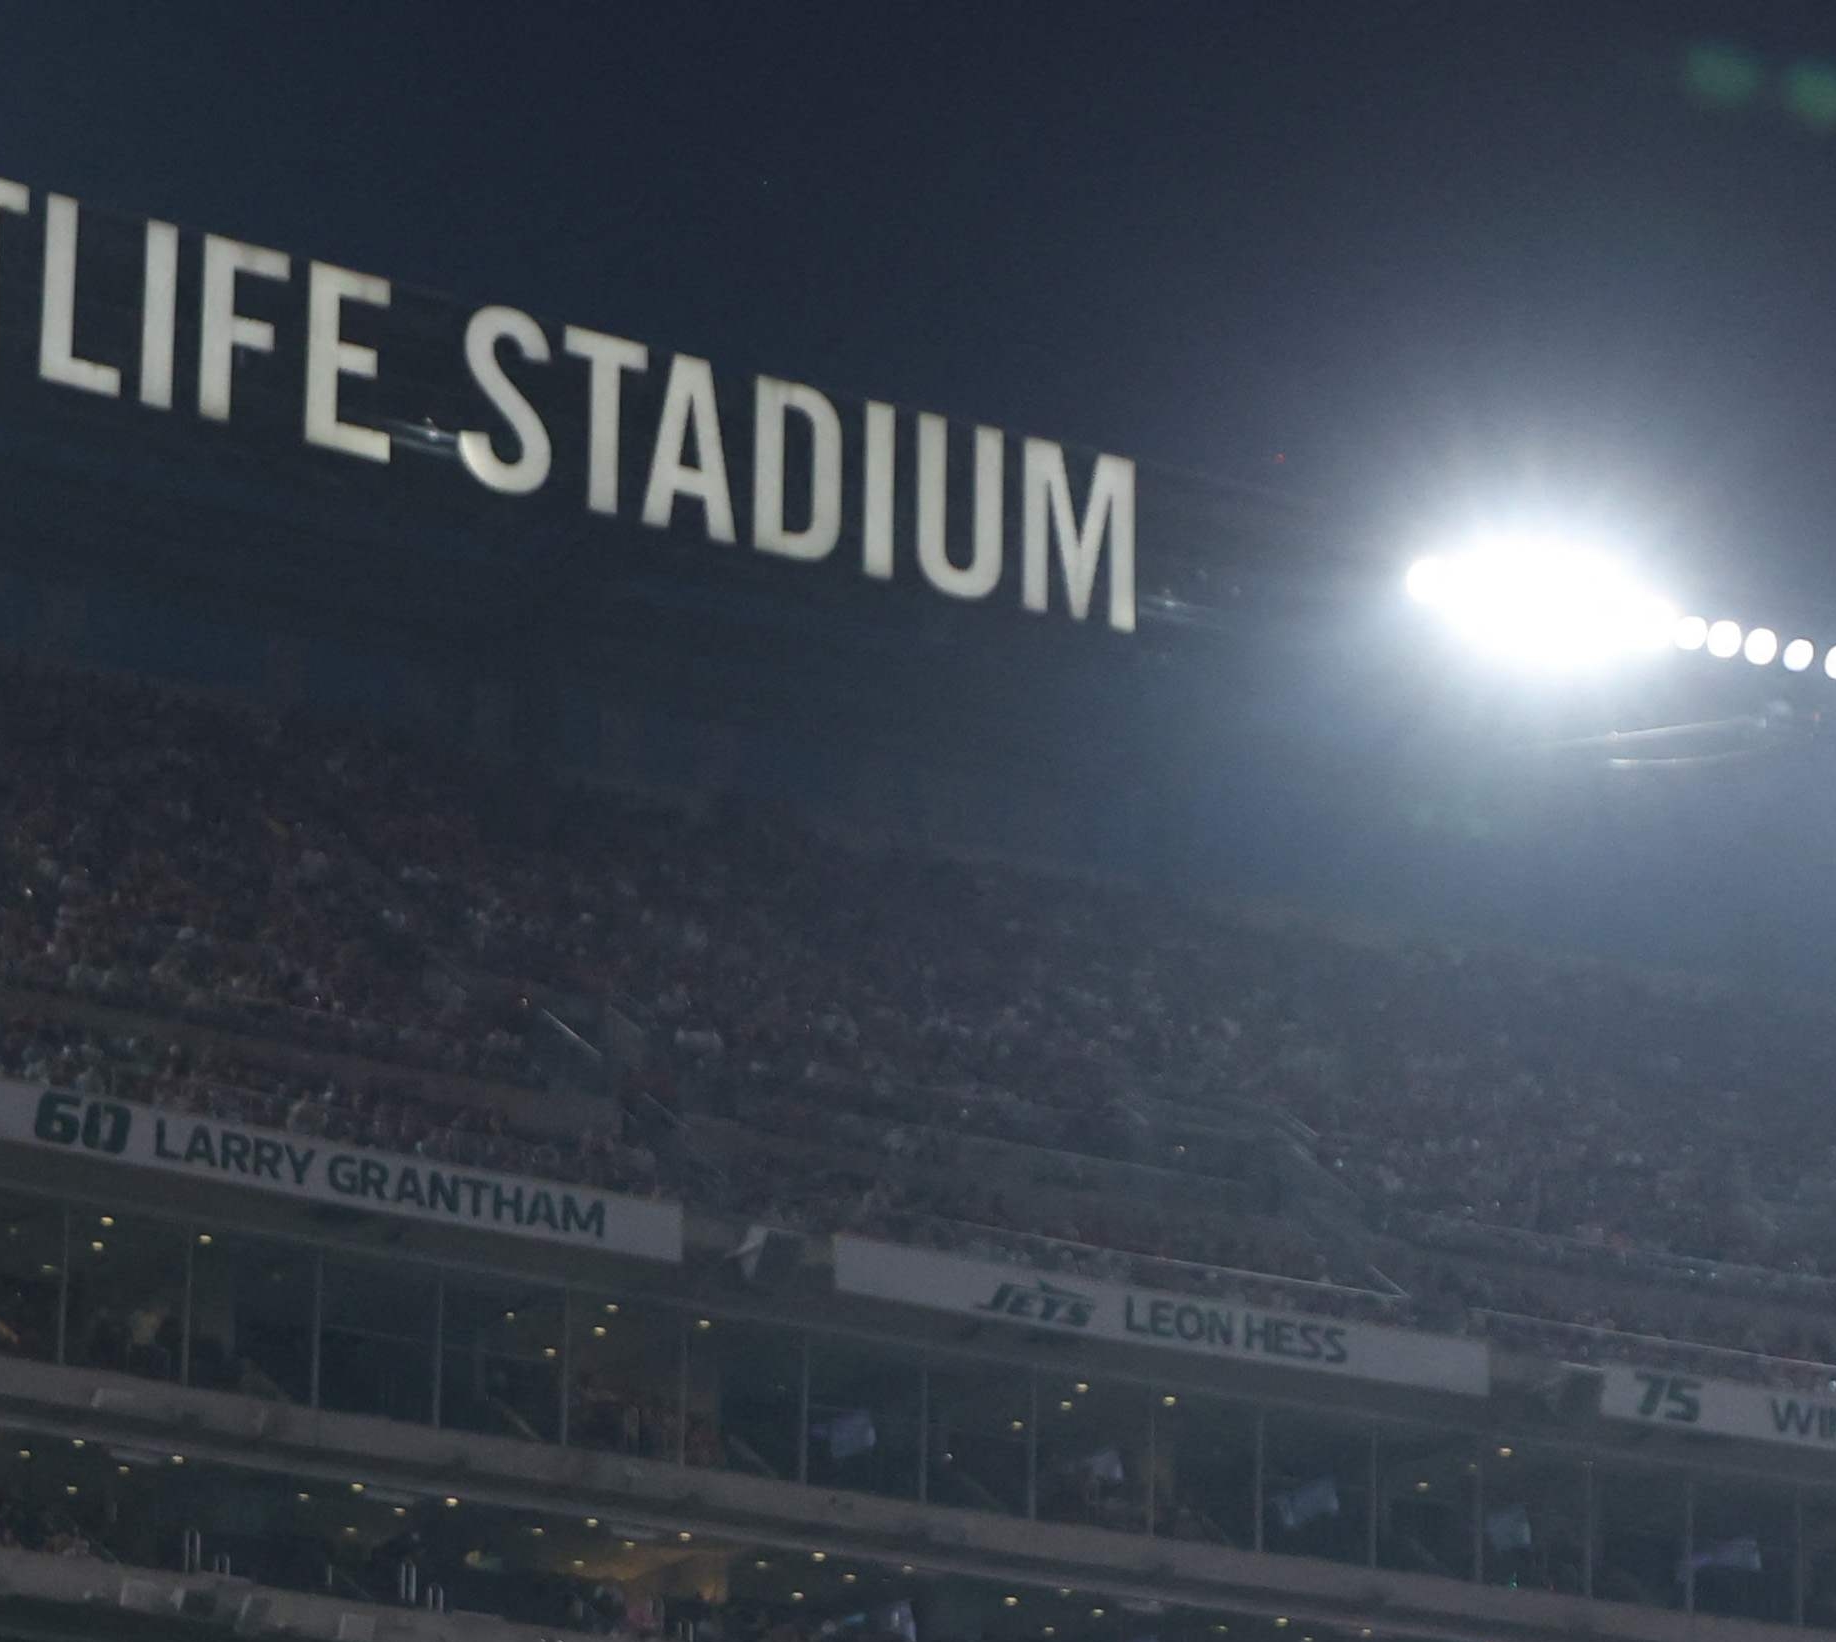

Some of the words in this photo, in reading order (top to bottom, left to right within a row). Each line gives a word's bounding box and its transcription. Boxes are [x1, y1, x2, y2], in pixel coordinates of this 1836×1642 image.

[456, 305, 1139, 632] STADIUM
[33, 1089, 133, 1155] 60
[155, 1117, 315, 1187] LARRY
[328, 1153, 607, 1239] GRANTHAM
[1125, 1296, 1234, 1346] LEON
[1244, 1316, 1348, 1364] HESS
[1635, 1373, 1702, 1423] 75
